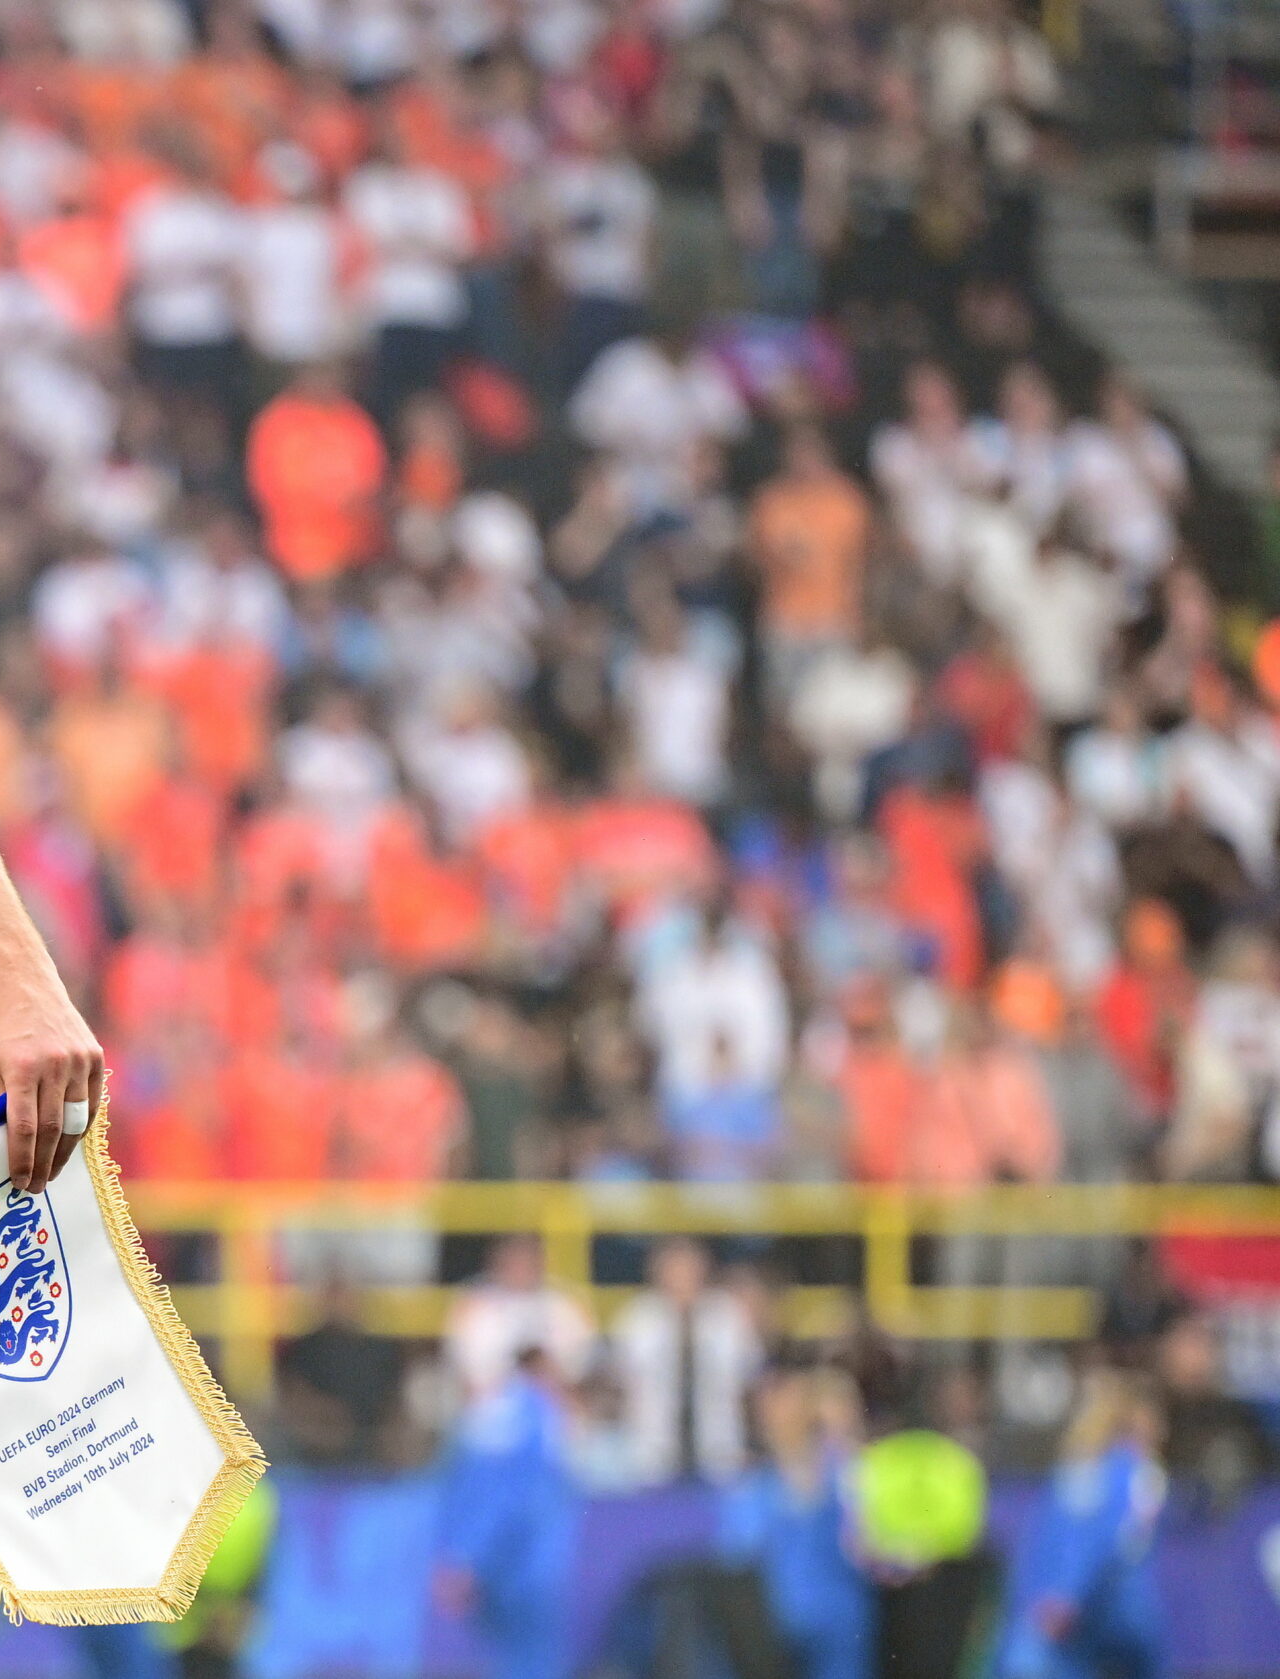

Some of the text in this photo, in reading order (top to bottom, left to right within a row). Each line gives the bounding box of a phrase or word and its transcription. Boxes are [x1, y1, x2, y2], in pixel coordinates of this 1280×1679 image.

[25, 1419, 57, 1446] EURO
[57, 1403, 82, 1426] 2024
[81, 1376, 126, 1410] Germany
[45, 1418, 97, 1459] Semi Final
[22, 1417, 140, 1498] BVB Stadion, Dortmund
[26, 1432, 156, 1521] Wednesday 10th July 2024
